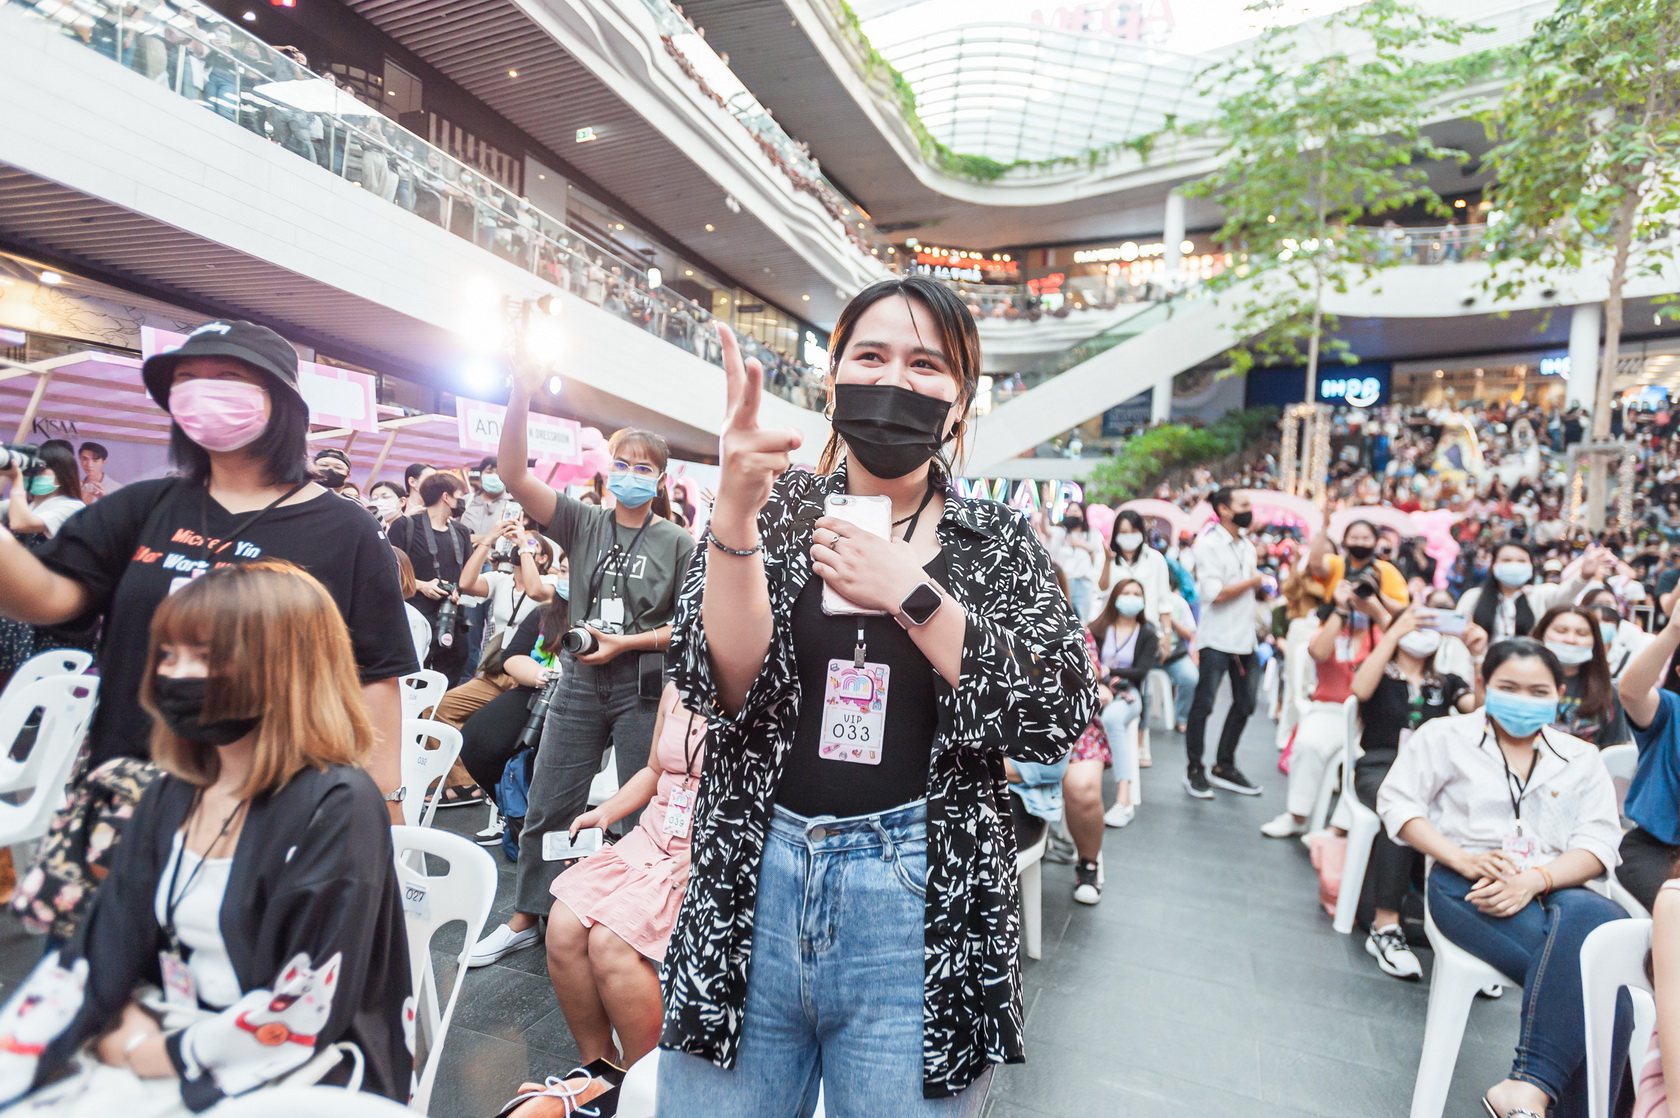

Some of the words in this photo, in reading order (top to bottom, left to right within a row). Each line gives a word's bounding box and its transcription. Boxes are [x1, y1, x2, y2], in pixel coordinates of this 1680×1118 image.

[234, 541, 261, 558] Yin
[843, 714, 862, 724] VIP
[832, 723, 870, 741] 033
[668, 816, 685, 828] 039
[405, 888, 426, 903] 027
